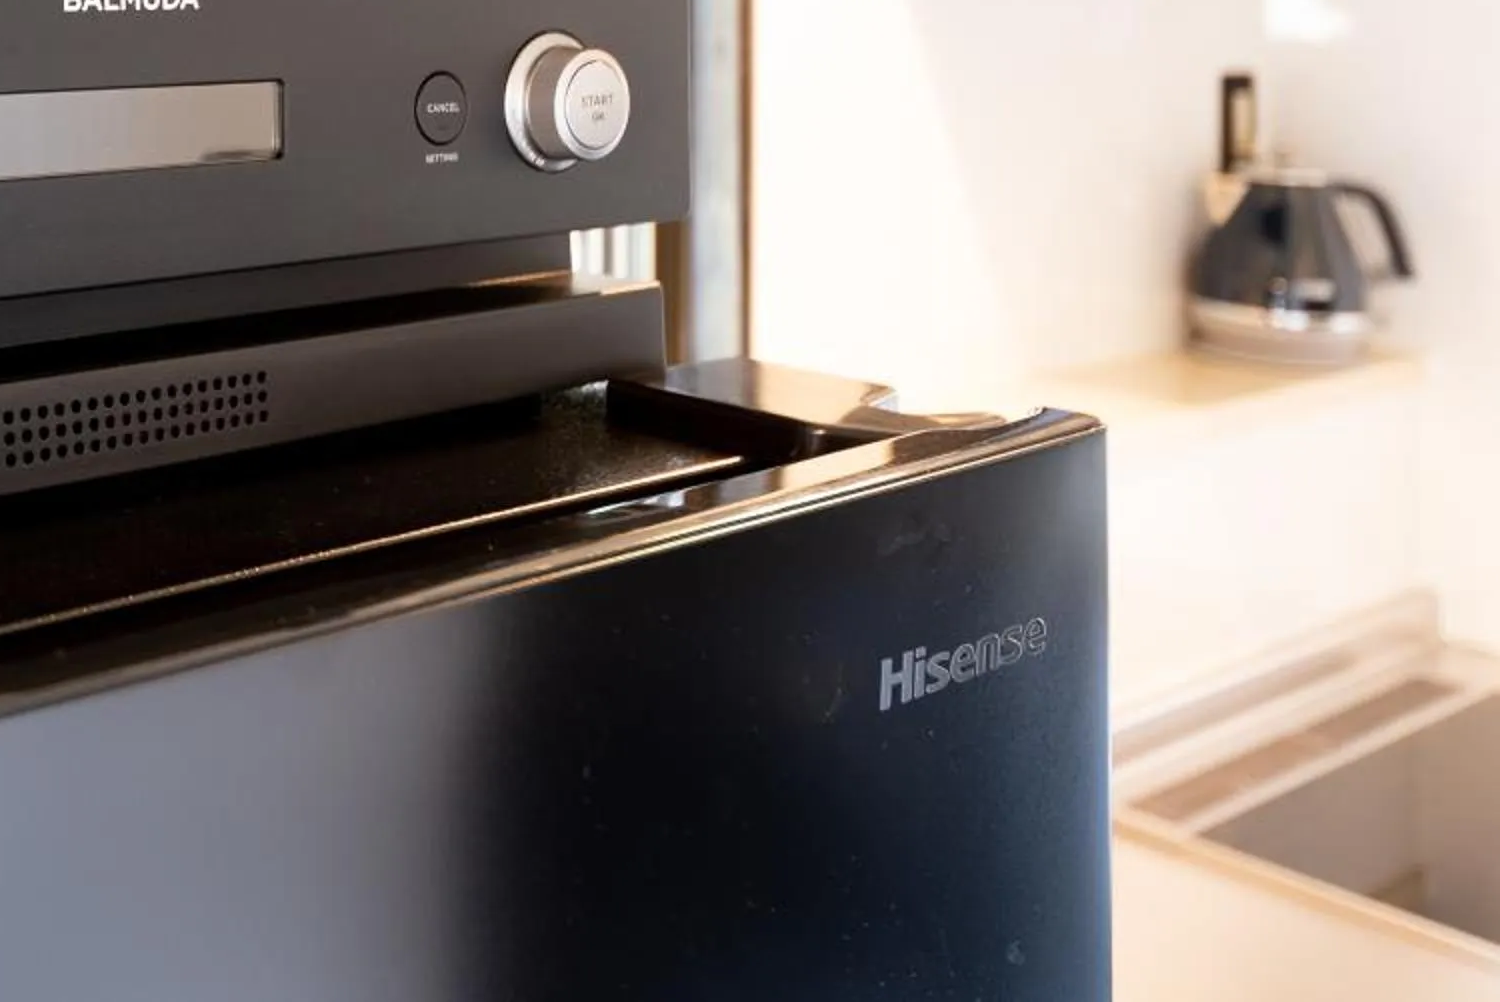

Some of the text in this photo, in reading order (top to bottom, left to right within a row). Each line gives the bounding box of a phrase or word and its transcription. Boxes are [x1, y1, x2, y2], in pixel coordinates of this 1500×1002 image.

[581, 94, 613, 107] START
[426, 102, 461, 114] CANCEL
[879, 616, 1048, 711] Hisense
